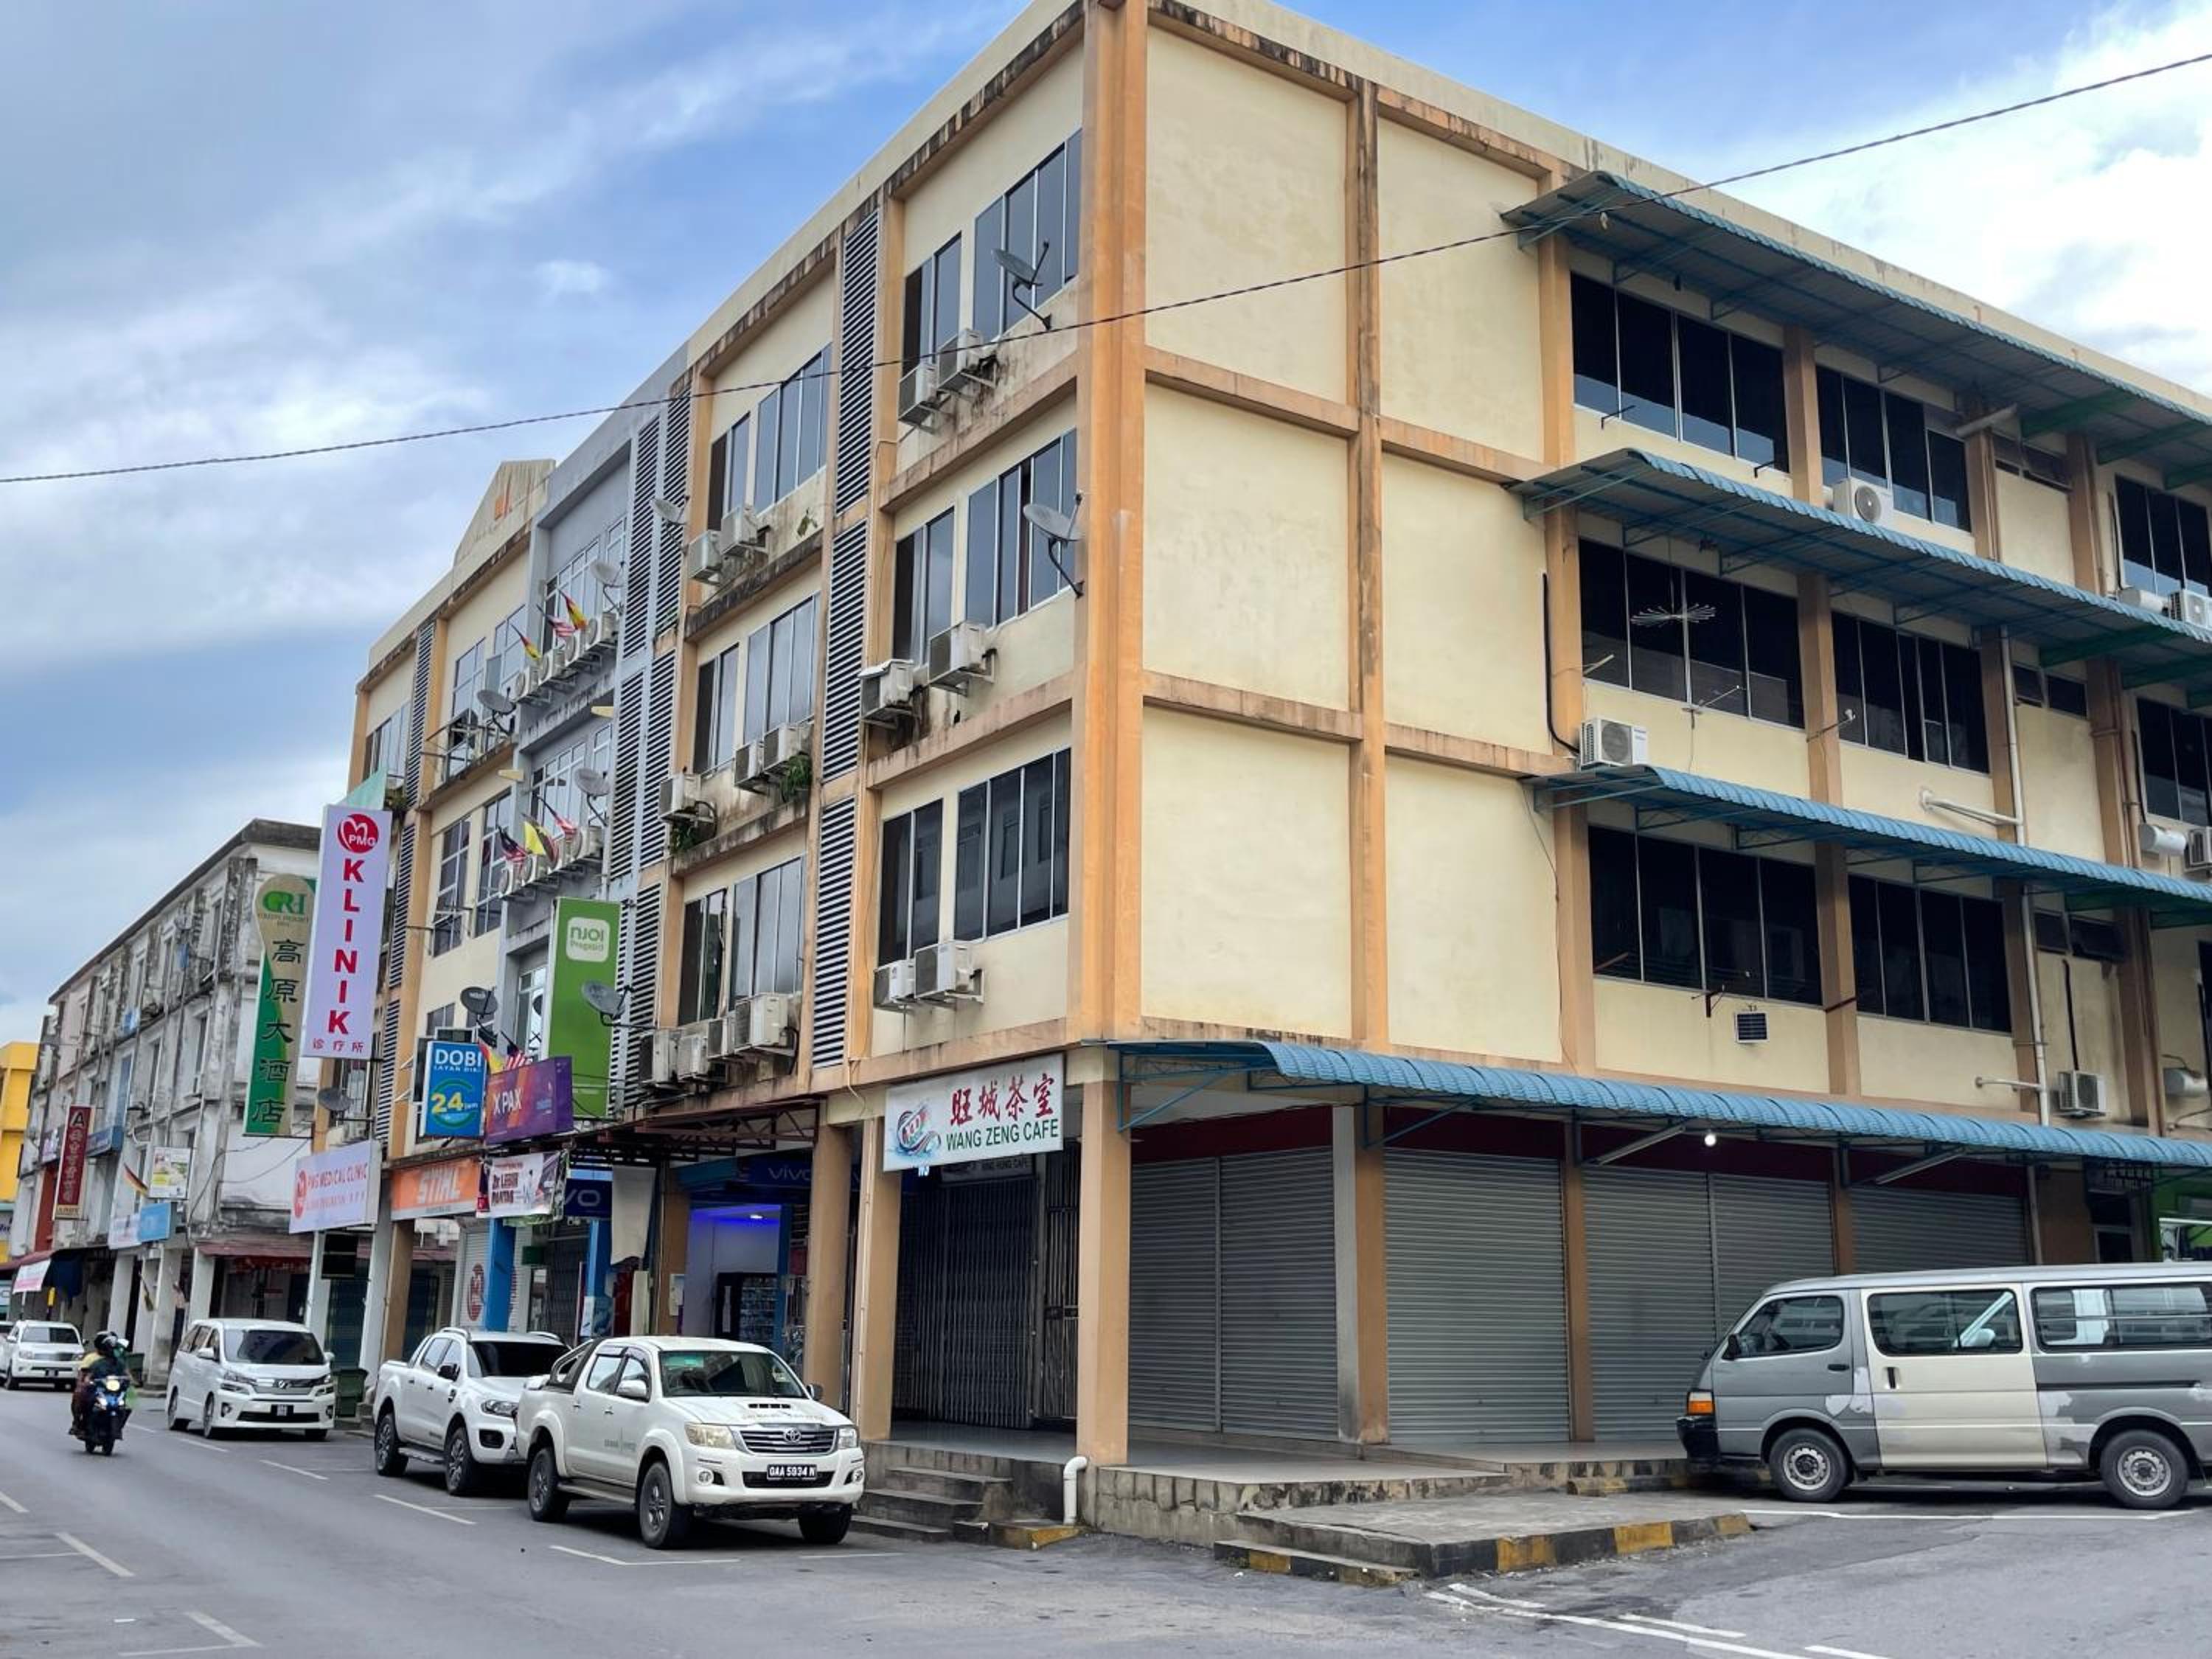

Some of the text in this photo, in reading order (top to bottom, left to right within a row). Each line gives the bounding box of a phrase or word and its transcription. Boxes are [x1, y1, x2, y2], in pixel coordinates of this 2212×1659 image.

[328, 858, 365, 1034] KLINIK
[252, 939, 305, 1124] 高原大酒店
[435, 1048, 482, 1067] DOBI
[431, 1092, 464, 1114] 24
[950, 1074, 1055, 1127] 旺城茶室
[946, 1119, 1059, 1151] WANG ZENG CAFE
[417, 1166, 461, 1204] STIHL
